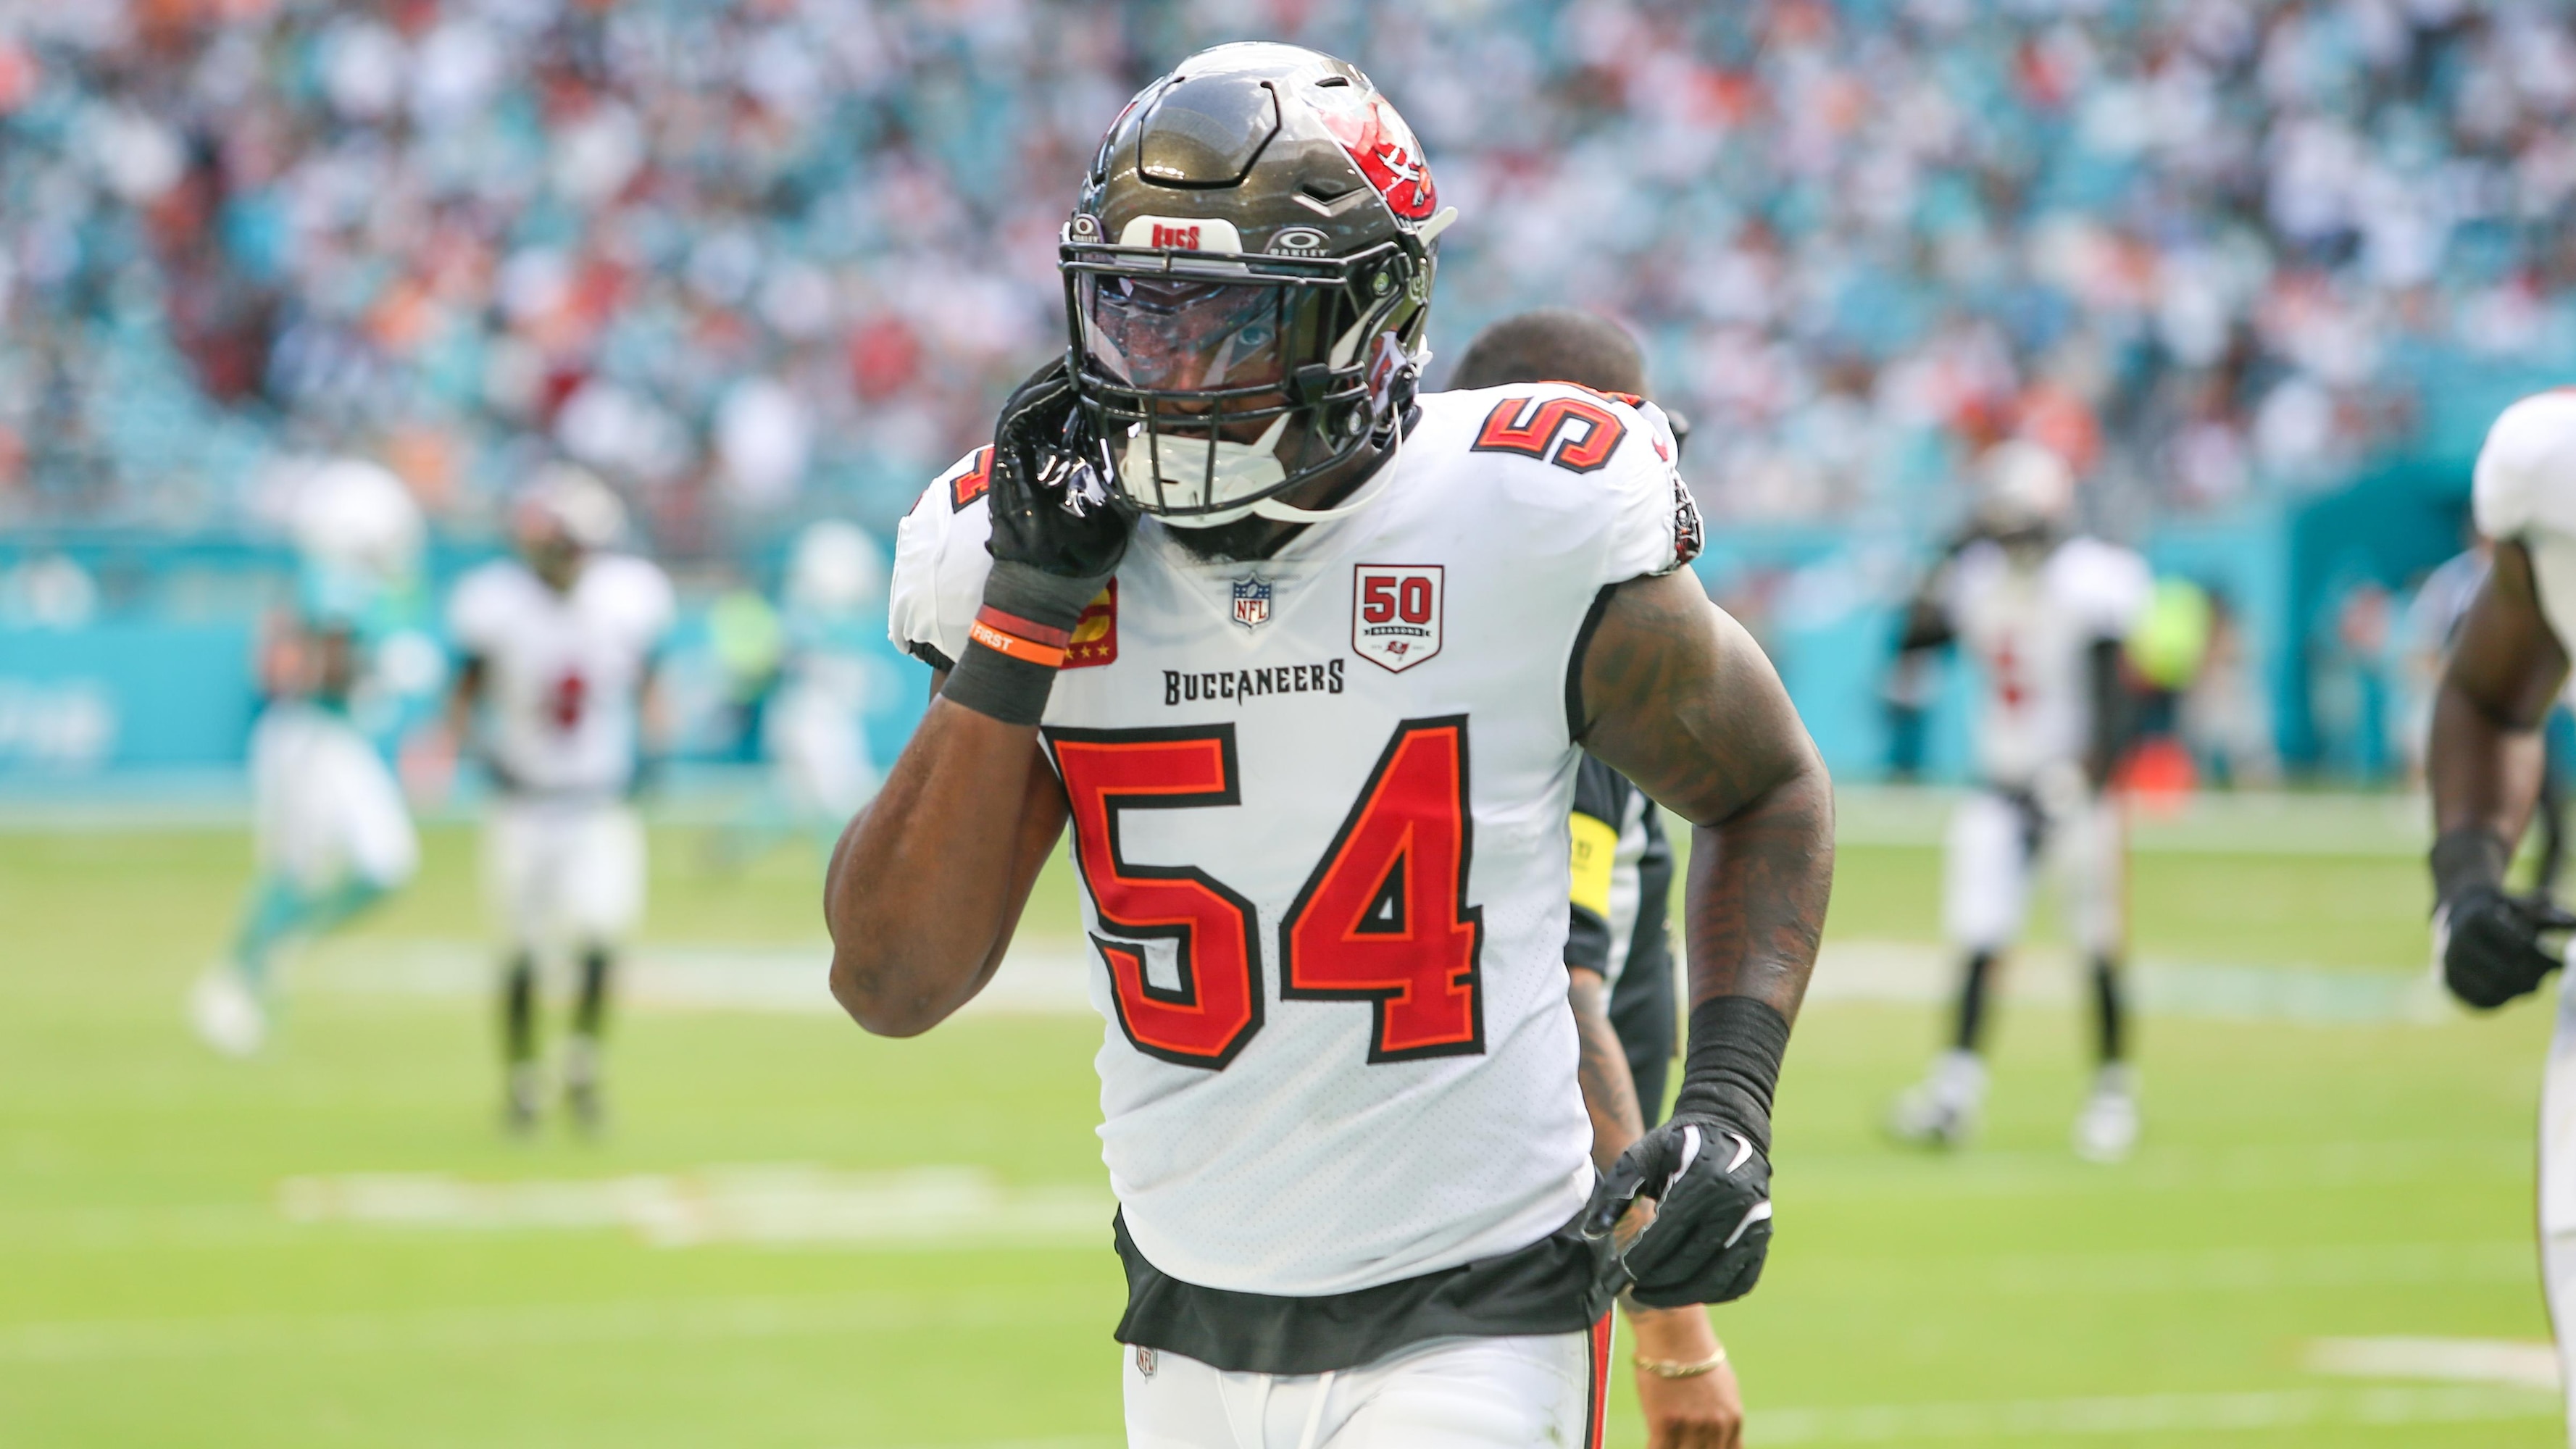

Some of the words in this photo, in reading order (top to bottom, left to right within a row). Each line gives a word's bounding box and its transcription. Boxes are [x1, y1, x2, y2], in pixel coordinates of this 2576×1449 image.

[1269, 248, 1330, 257] OAKLEY
[1470, 380, 1646, 475] 5
[1236, 600, 1267, 622] NFL
[1364, 576, 1433, 625] 50
[1040, 713, 1486, 1072] 54
[1138, 1345, 1154, 1371] NFL
